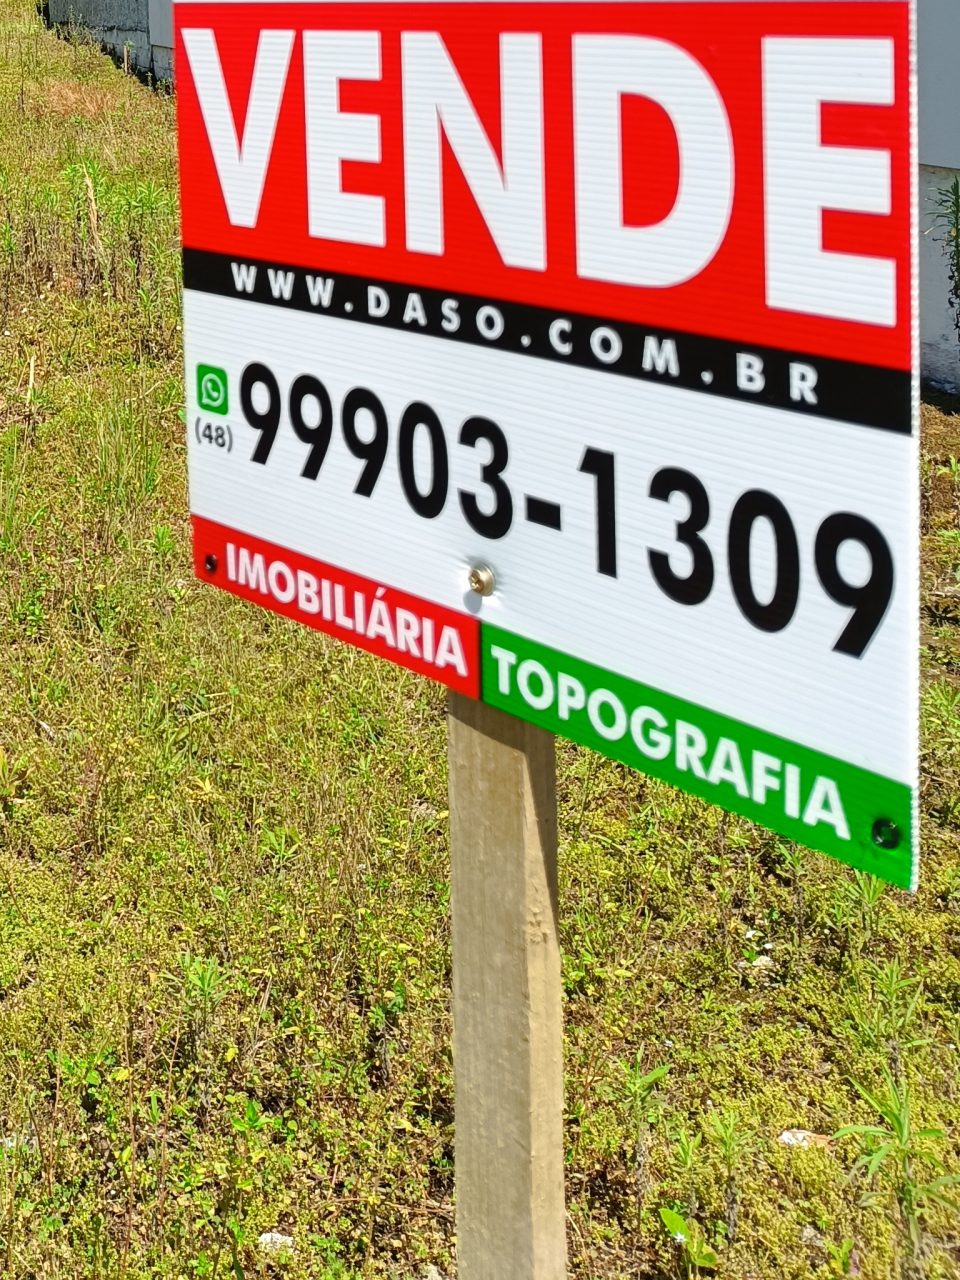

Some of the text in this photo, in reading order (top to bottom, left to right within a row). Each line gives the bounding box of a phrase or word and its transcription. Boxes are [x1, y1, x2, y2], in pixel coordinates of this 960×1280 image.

[181, 28, 897, 327] VENDE
[230, 262, 819, 406] WWW.DASO.COM.BR
[194, 419, 233, 453] (48)
[240, 361, 894, 660] 99903-1309
[226, 542, 469, 677] IMOBILIÁRIA
[490, 644, 851, 841] TOPOGRAFIA
